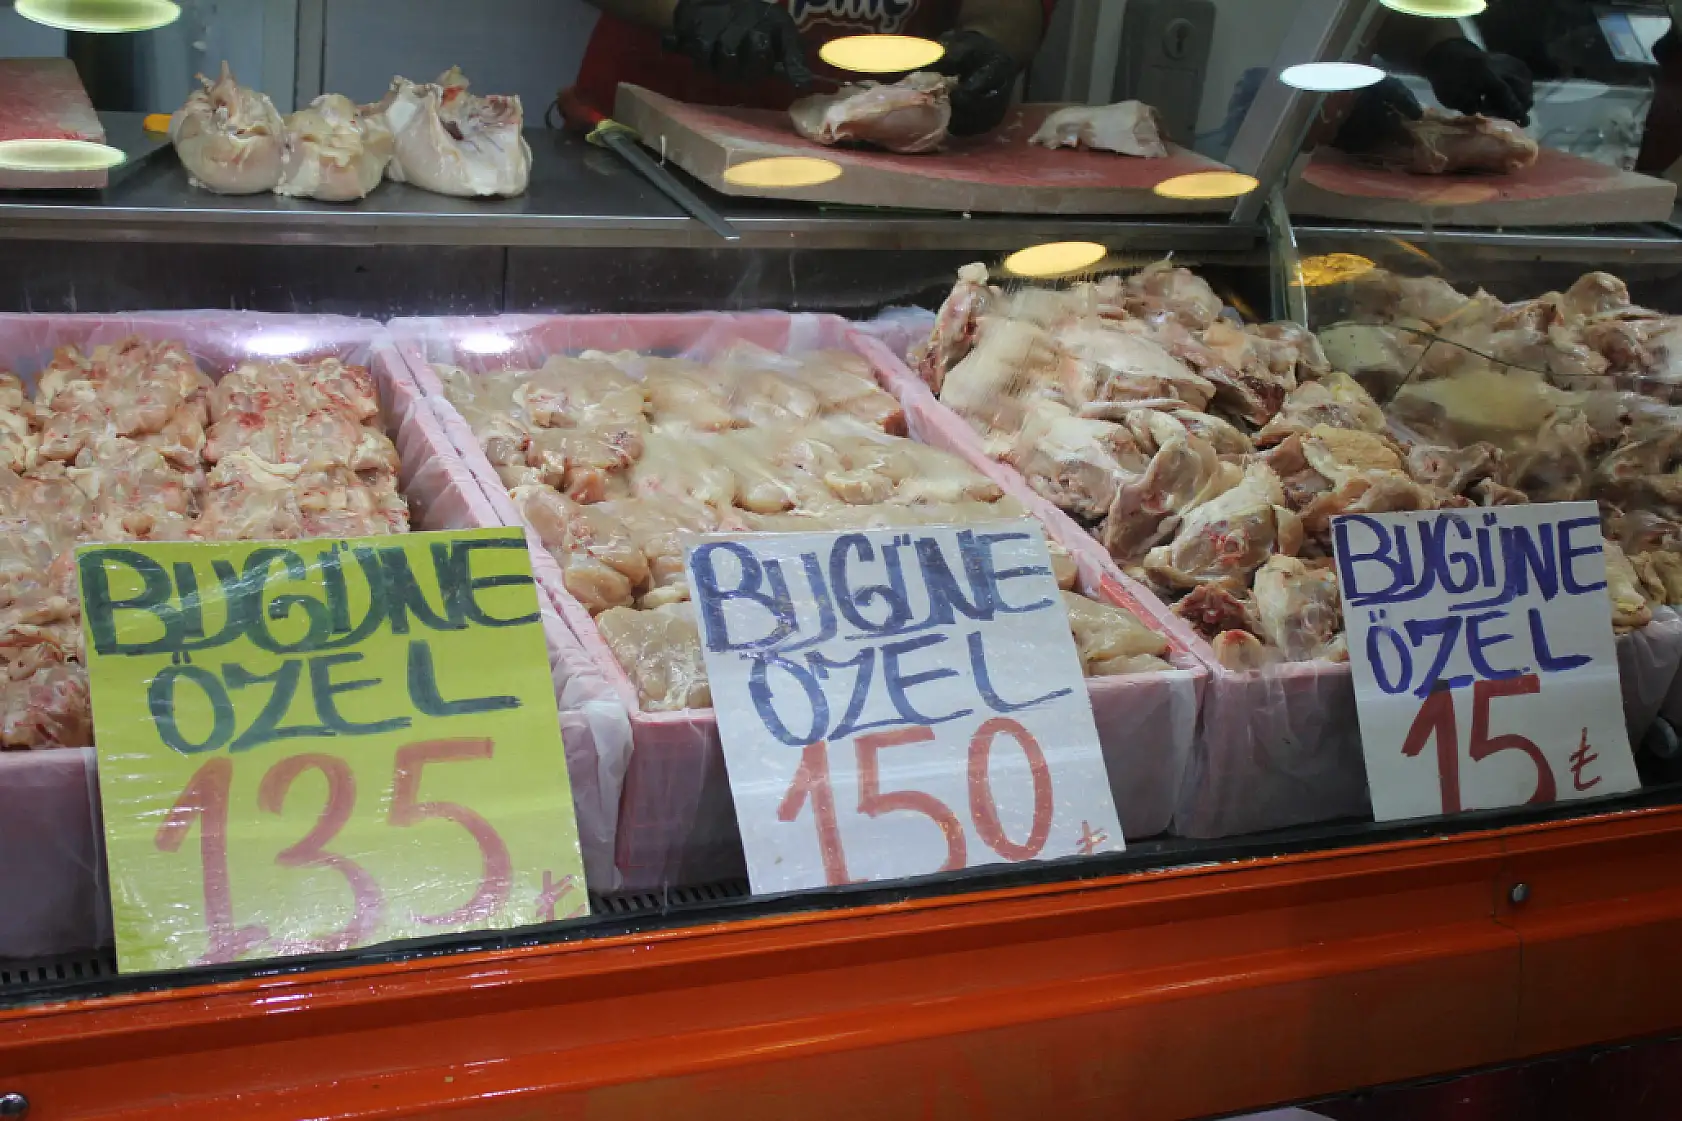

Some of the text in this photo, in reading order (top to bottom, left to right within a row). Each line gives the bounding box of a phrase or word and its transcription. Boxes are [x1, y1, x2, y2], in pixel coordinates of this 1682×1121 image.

[77, 539, 542, 655] BUGÜNE
[690, 529, 1055, 653] BUGÜNE
[1332, 512, 1608, 610] BUGÜNE
[147, 640, 521, 754] ÖZEL
[748, 631, 1073, 746] ÖZEL
[1366, 608, 1593, 698] ÖZEL
[153, 737, 513, 965] 135
[777, 717, 1054, 886] 150
